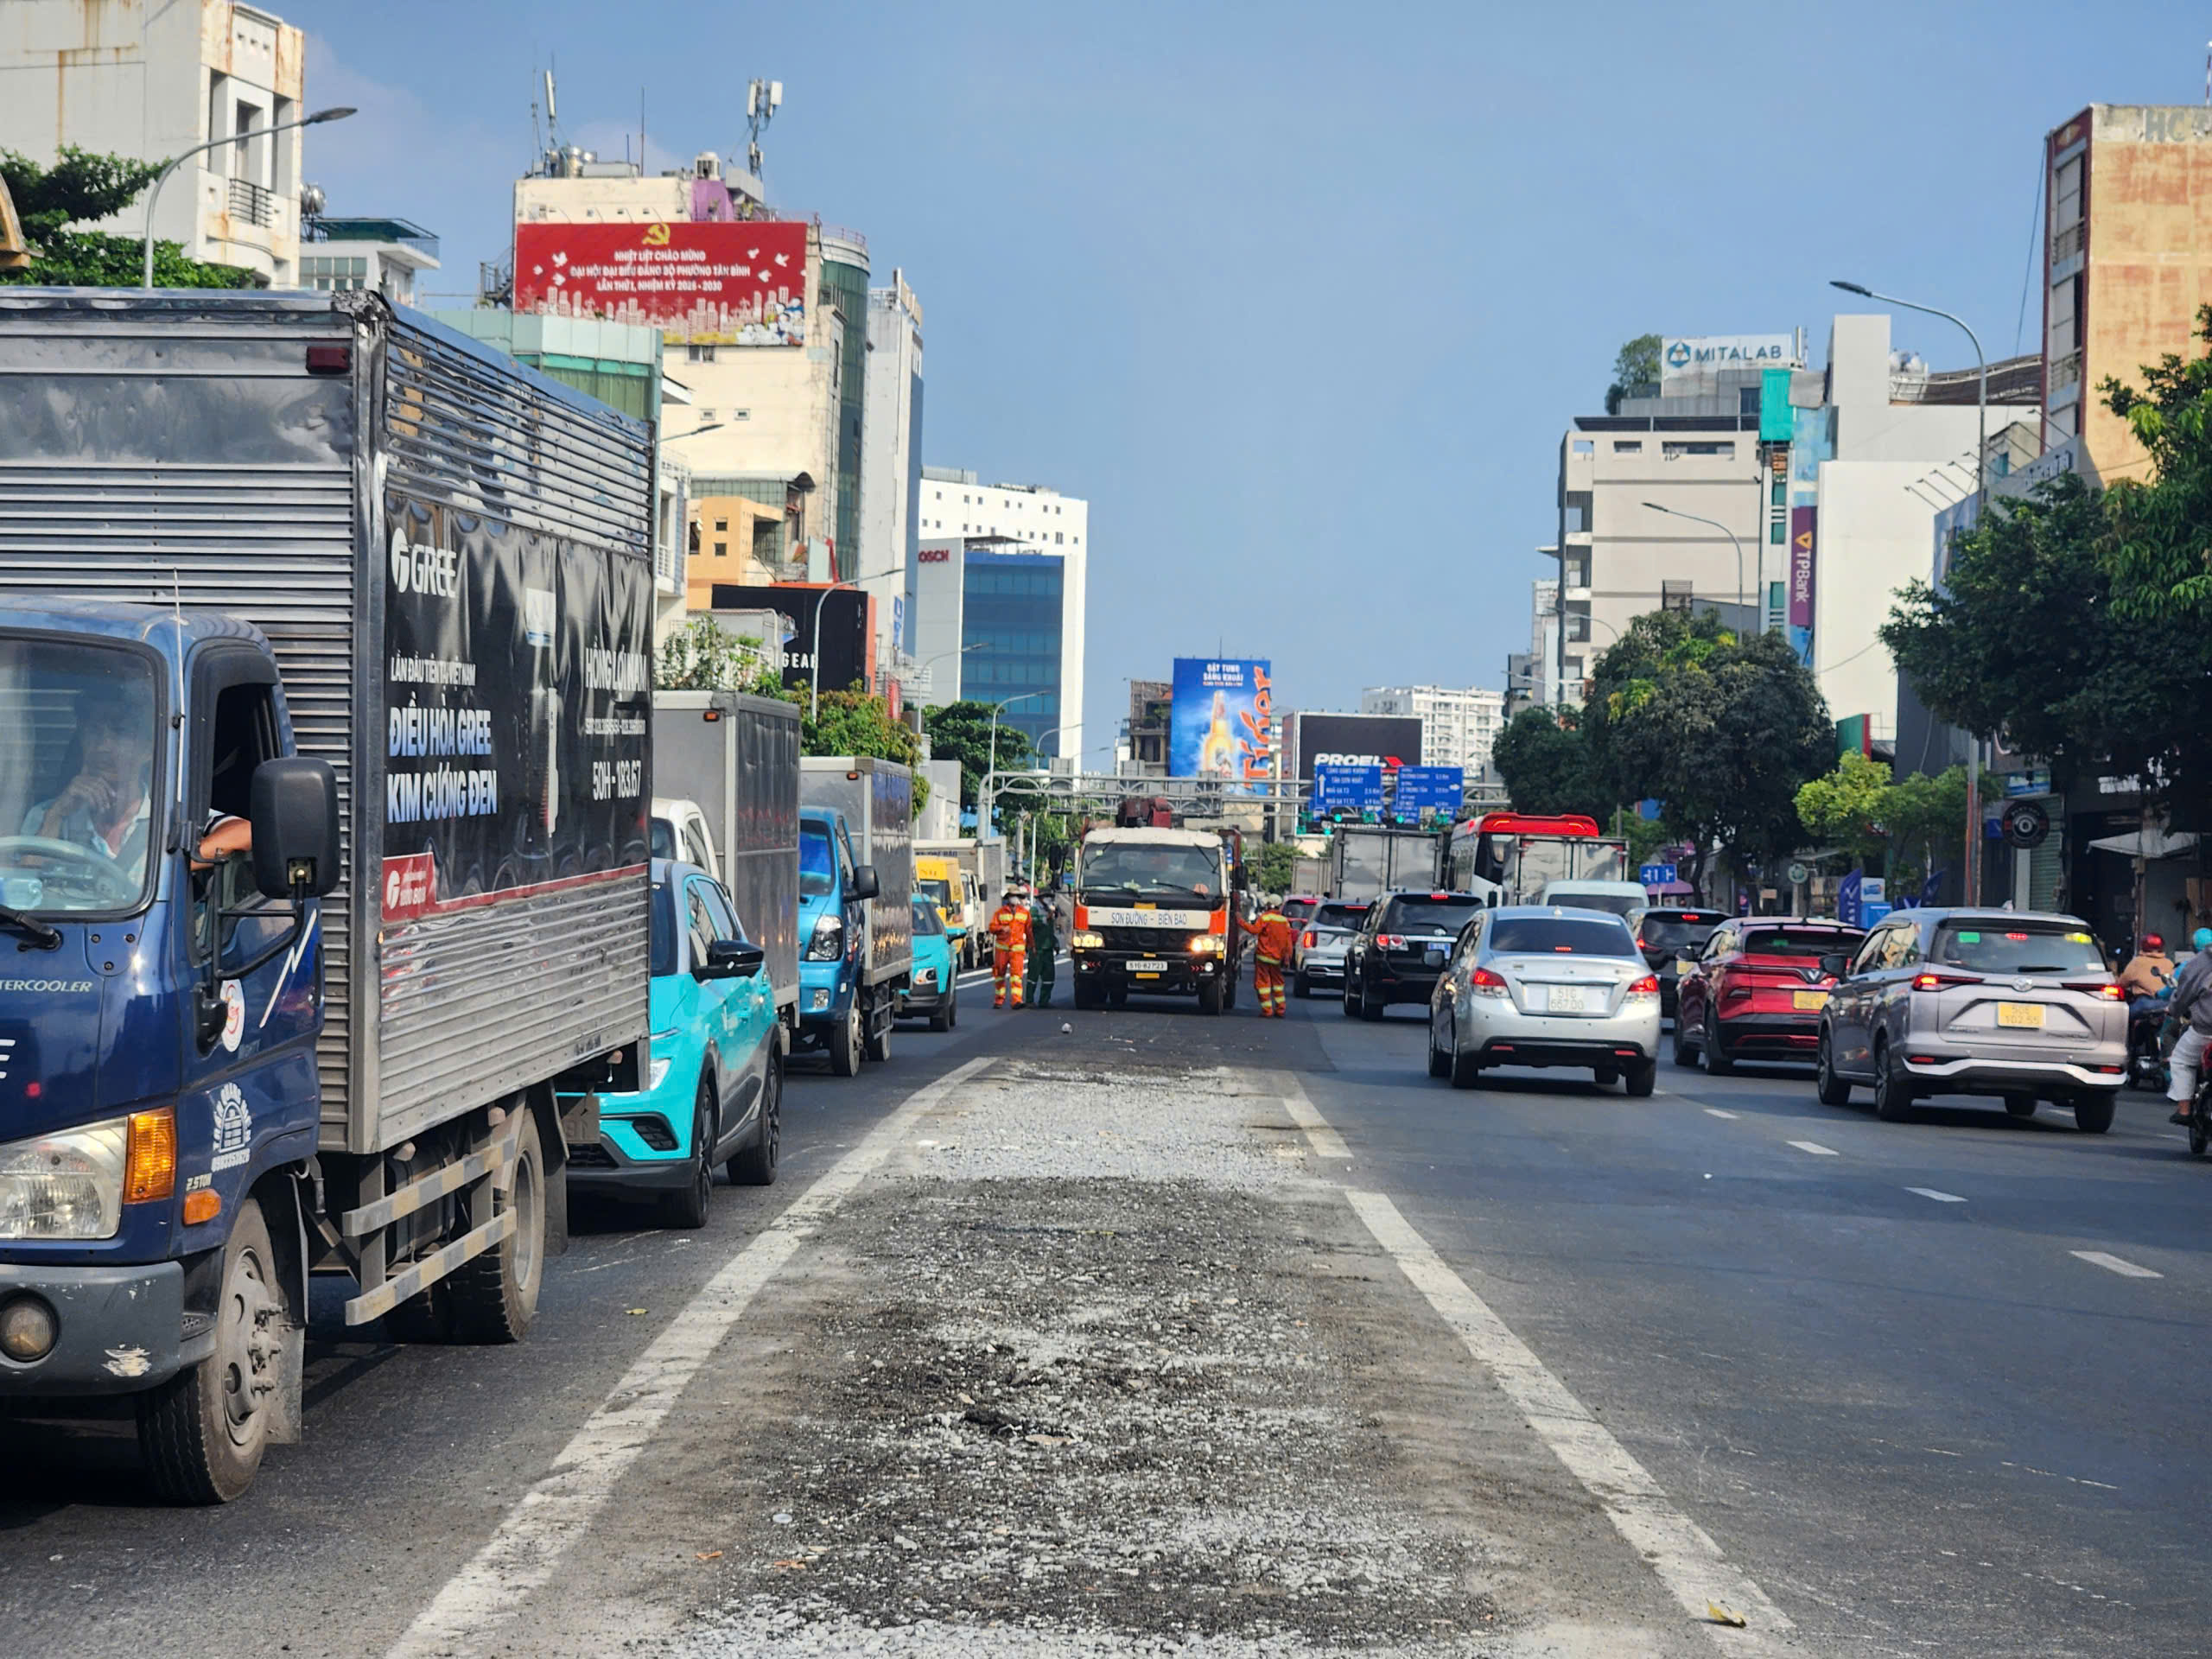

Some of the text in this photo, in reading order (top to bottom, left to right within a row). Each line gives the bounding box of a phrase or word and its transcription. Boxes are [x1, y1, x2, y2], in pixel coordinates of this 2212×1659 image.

[654, 248, 679, 261] CHÀO
[1695, 345, 1782, 360] MITALAB
[411, 543, 456, 598] GREE
[918, 550, 949, 563] OSCH
[1796, 550, 1811, 602] TPBank
[391, 649, 407, 682] LẦN
[586, 635, 612, 690] HỒNG
[389, 691, 492, 757] ĐIỀU HÒA GREE
[387, 761, 498, 823] KIM CƯƠNG ĐEN
[593, 761, 611, 800] 50H
[0, 979, 92, 992] TERCOOLER
